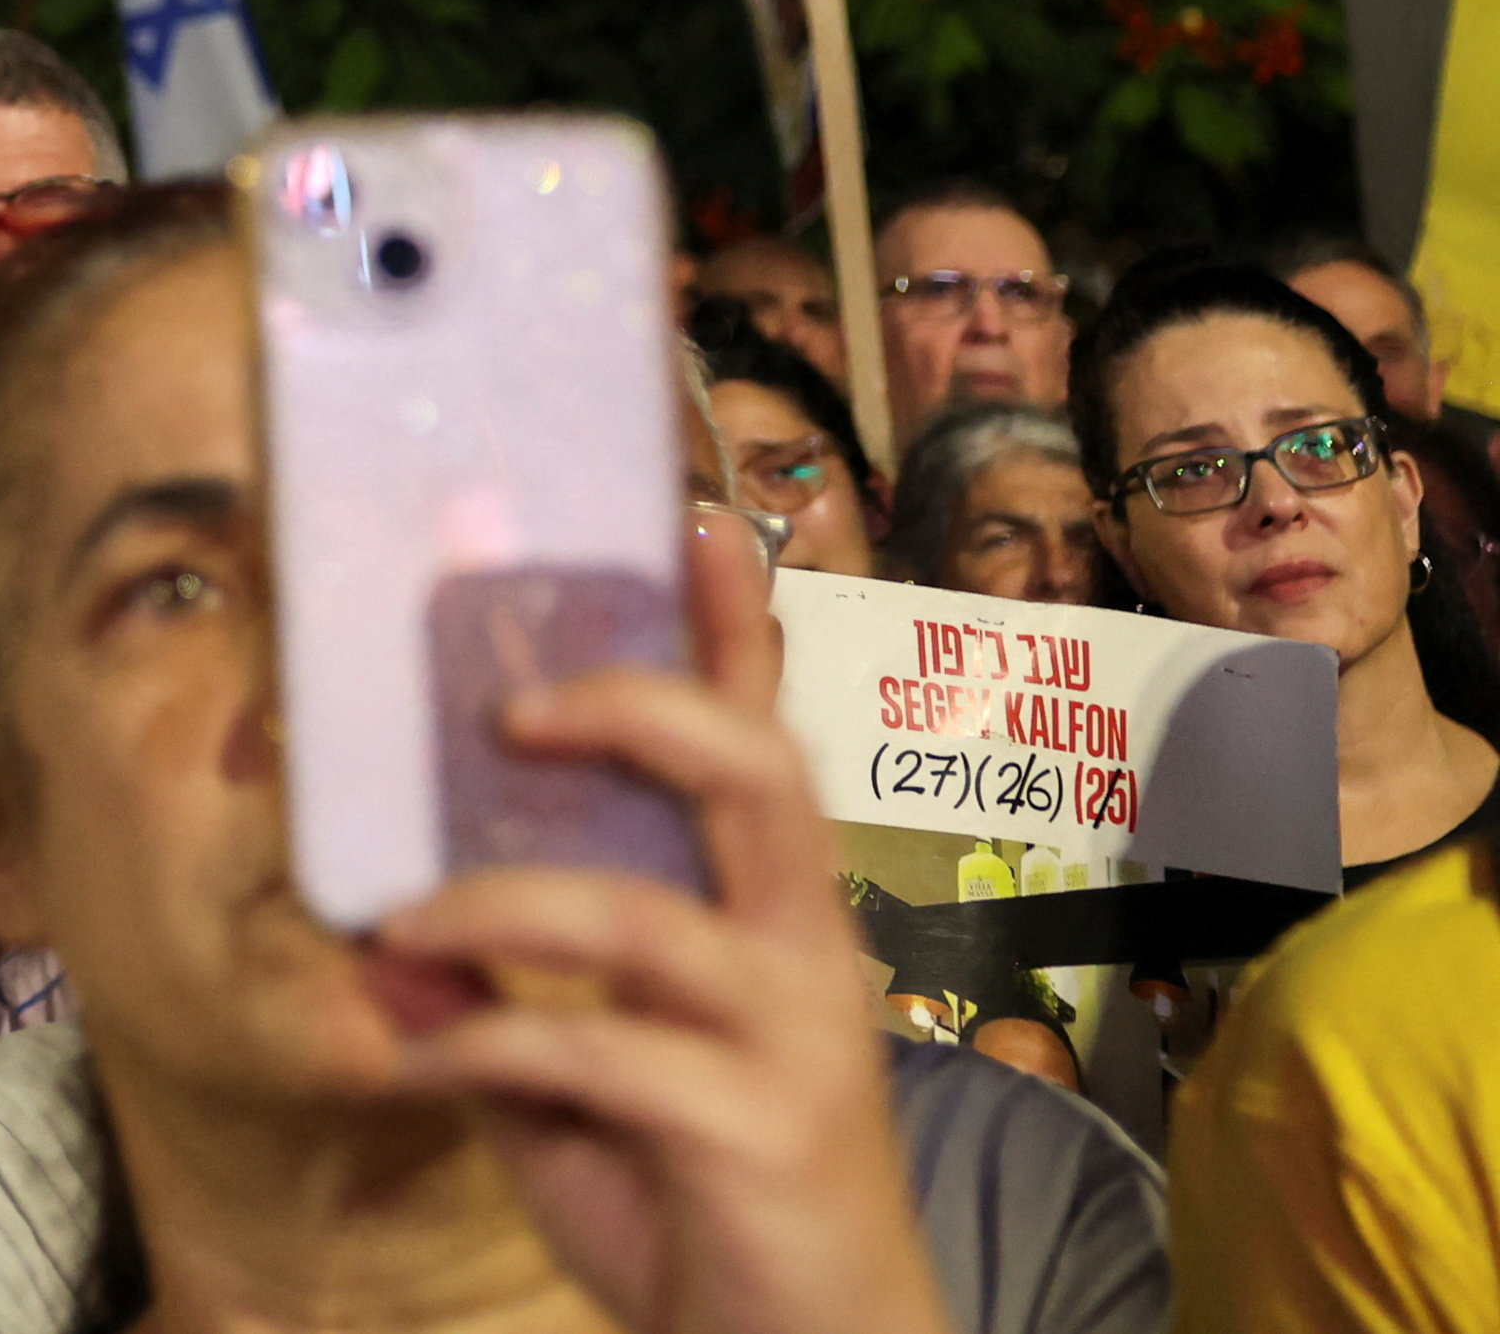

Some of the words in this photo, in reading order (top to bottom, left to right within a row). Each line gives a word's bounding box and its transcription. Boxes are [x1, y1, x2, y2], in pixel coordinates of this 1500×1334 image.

[1016, 632, 1091, 692] שגב
[879, 675, 992, 740] SEGEV
[1004, 689, 1128, 762] KALFON
